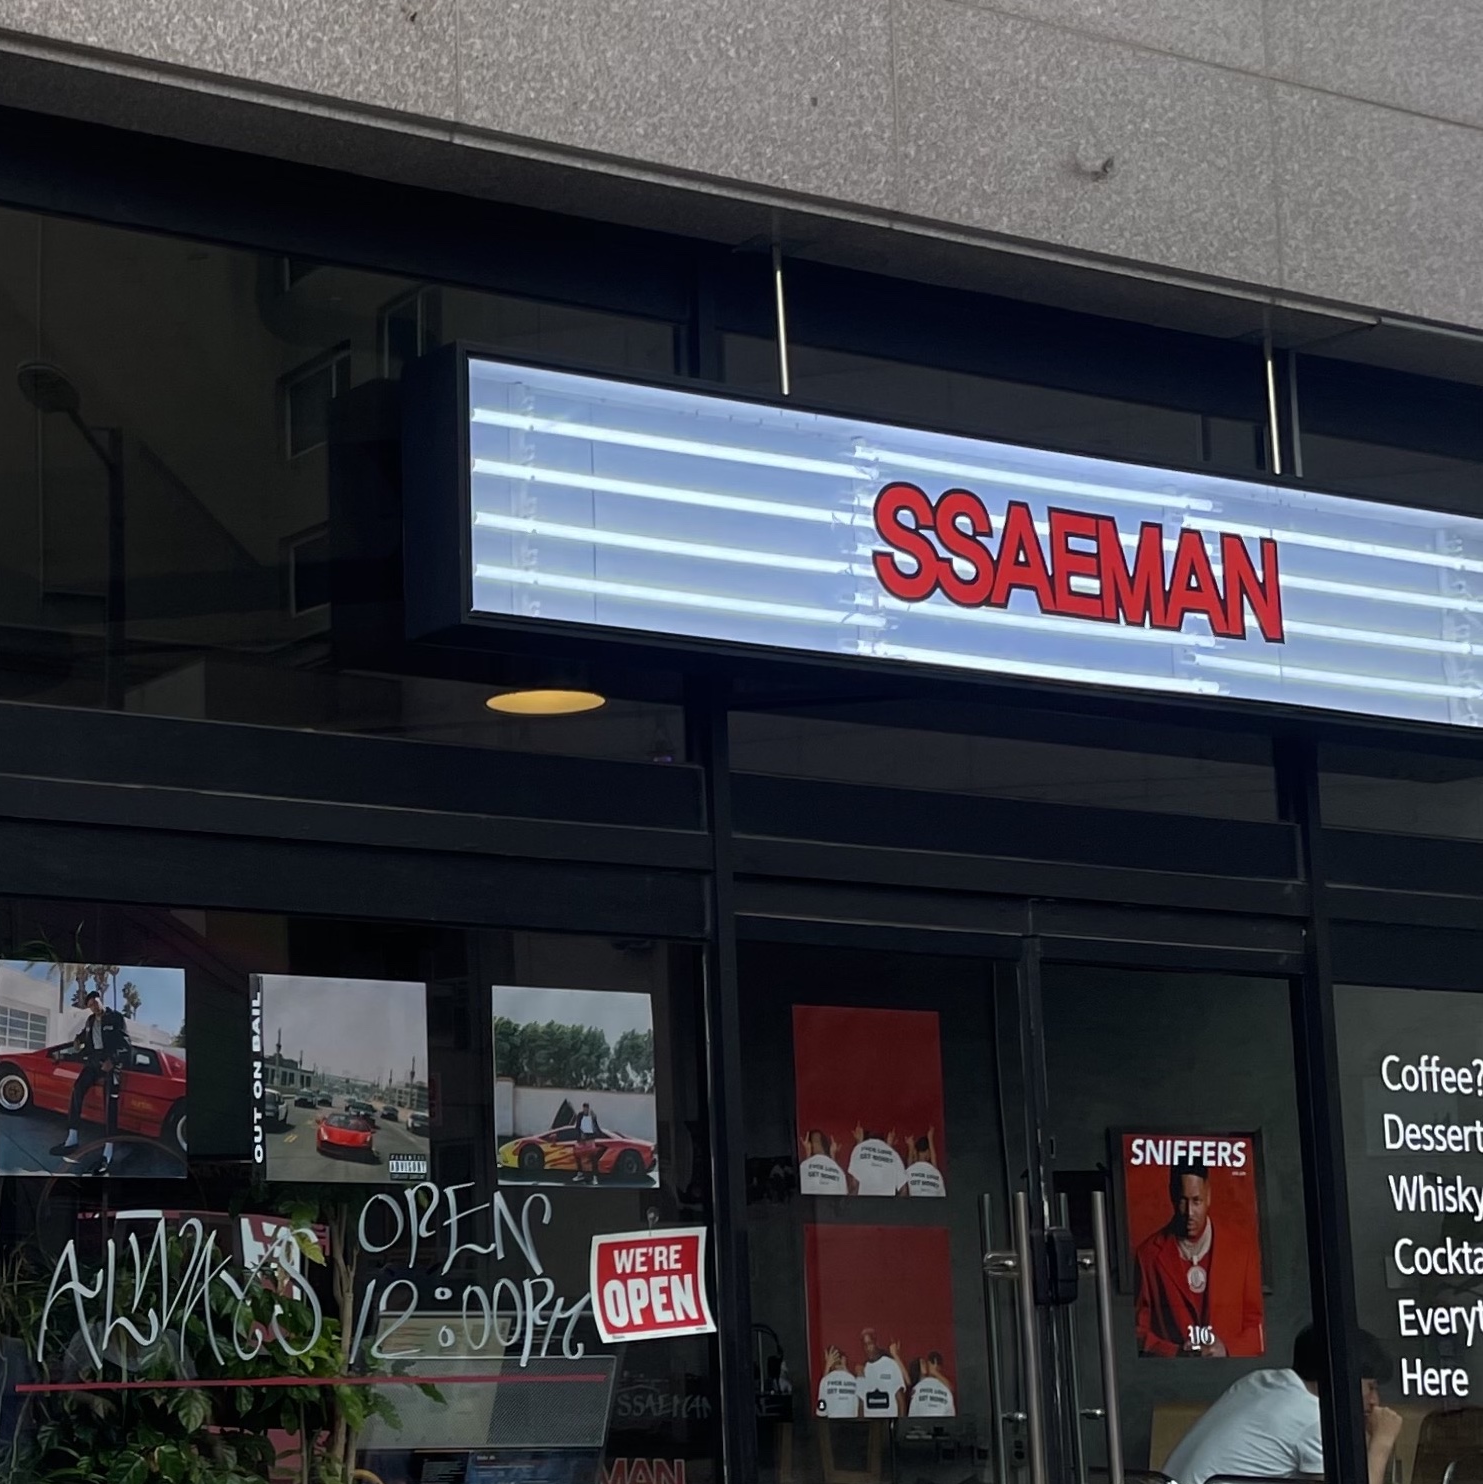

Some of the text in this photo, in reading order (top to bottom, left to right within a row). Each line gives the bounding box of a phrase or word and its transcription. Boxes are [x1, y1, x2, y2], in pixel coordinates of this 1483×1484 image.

[871, 481, 1285, 644] SSAEMAN
[251, 991, 264, 1163] OUT ON BAIL
[1130, 1138, 1247, 1168] SNIFFERS
[357, 1181, 552, 1275] OPEN
[613, 1244, 682, 1275] WE'RE
[36, 1214, 324, 1370] ALWAYS
[603, 1274, 700, 1328] OPEN
[1401, 1357, 1469, 1398] Here
